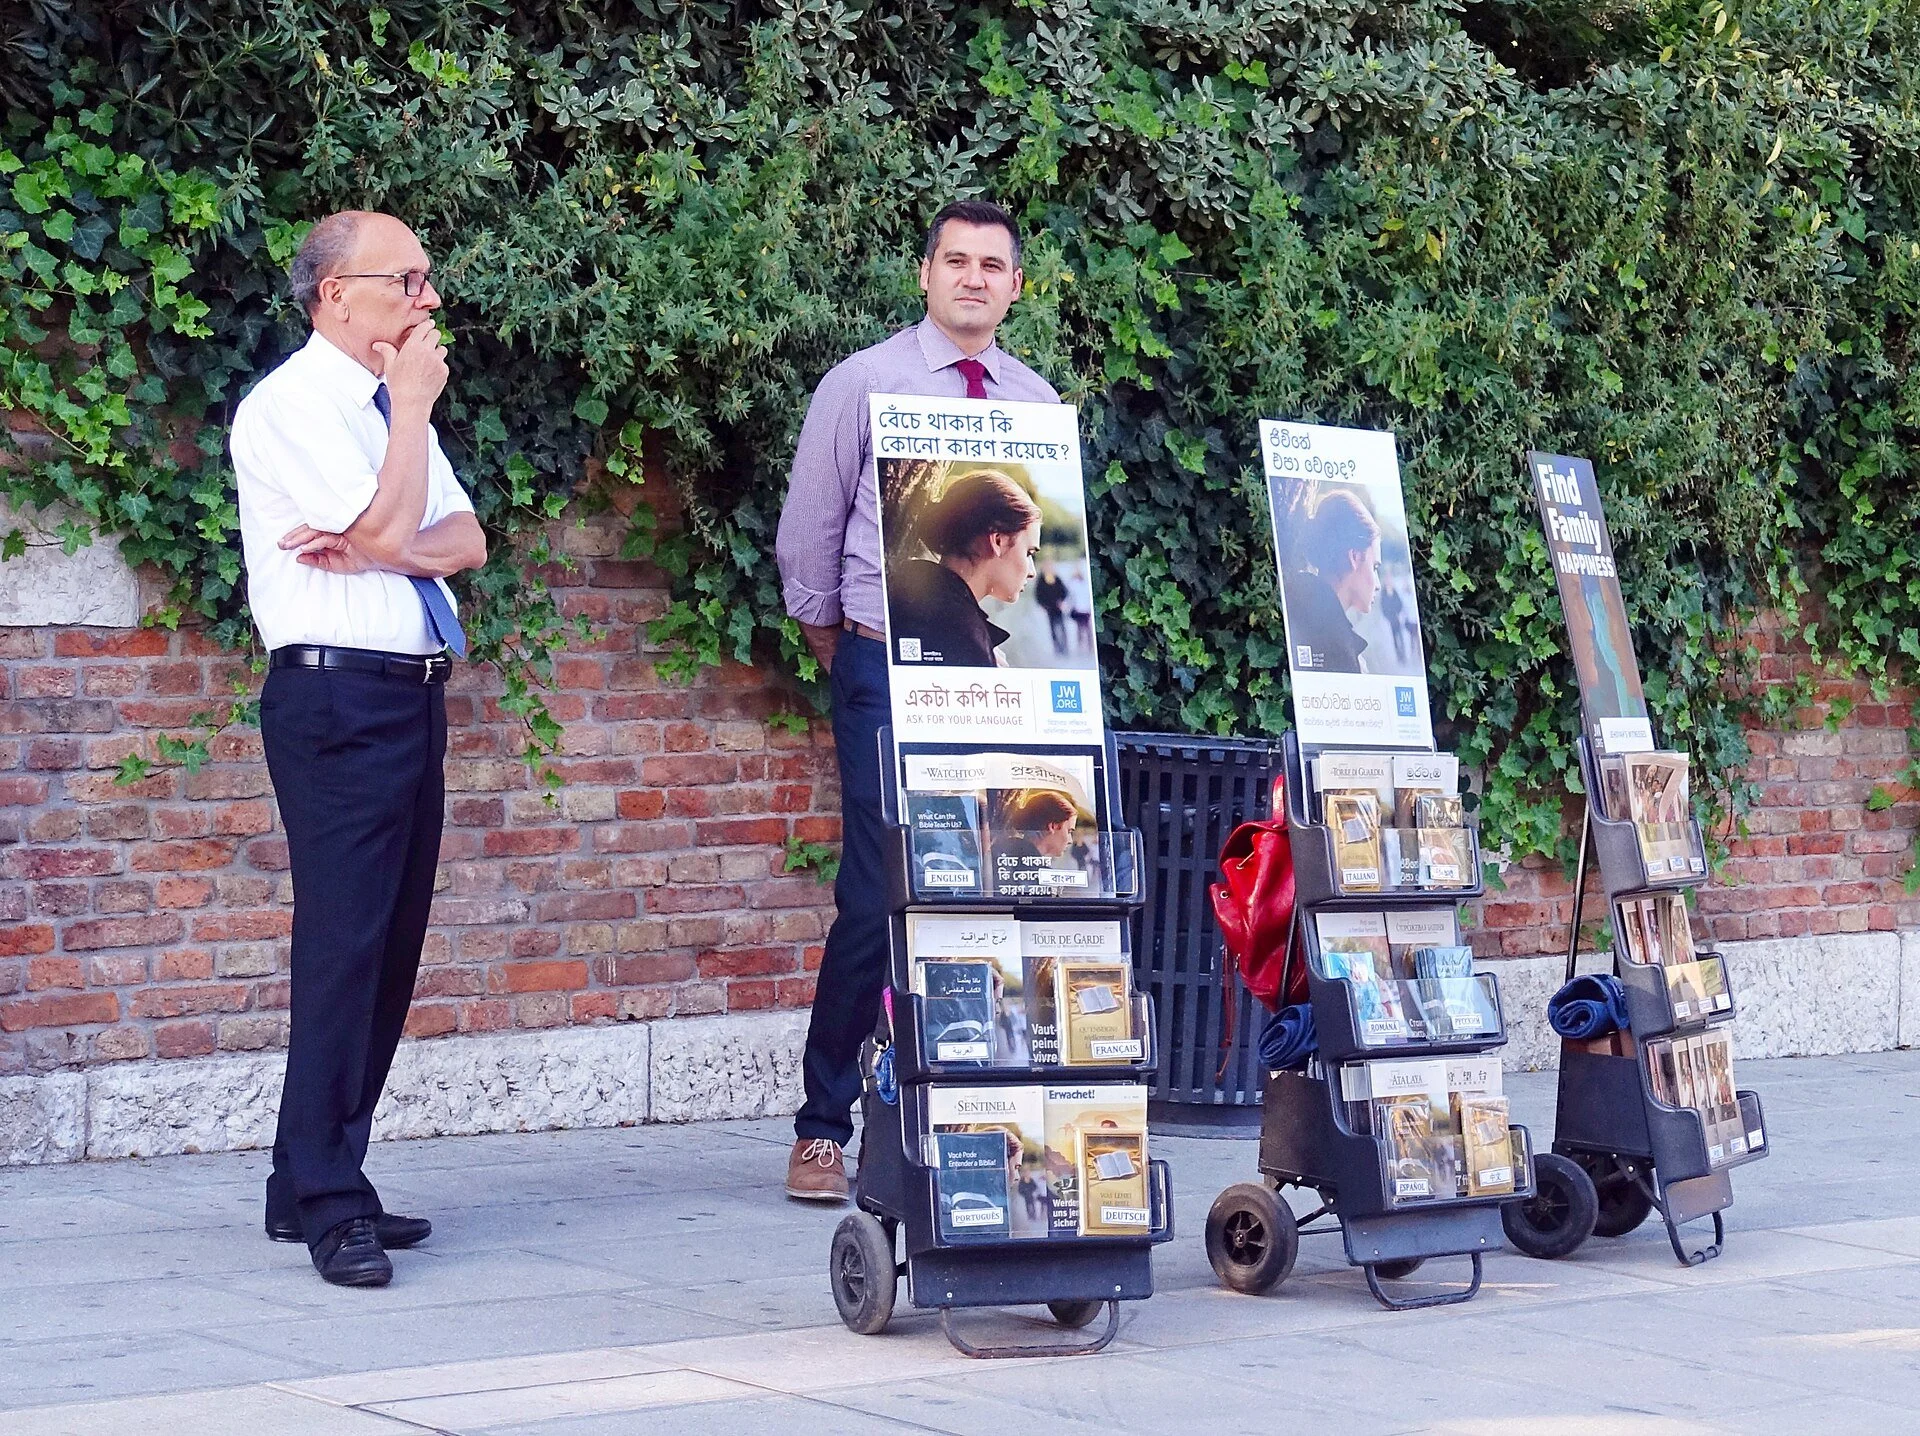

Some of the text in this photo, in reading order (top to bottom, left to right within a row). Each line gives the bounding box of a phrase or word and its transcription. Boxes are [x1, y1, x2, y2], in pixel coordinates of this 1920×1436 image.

[879, 404, 1013, 433] বেঁচে থাকার কি
[881, 435, 940, 455] কোনো
[945, 438, 996, 457] কারণ
[1537, 464, 1582, 506] Find
[1547, 507, 1602, 554] Family
[1557, 552, 1615, 577] HAPPINESS
[905, 683, 1022, 708] একটা কপি নিন
[1057, 685, 1076, 698] JW
[1400, 691, 1412, 703] JW
[906, 715, 1023, 726] ASK FOR YOUR LANGUAGE
[997, 853, 1052, 867] বেঁচে থাকার
[930, 873, 969, 884] ENGLISH
[998, 867, 1010, 881] কি
[1051, 874, 1075, 884] বাংলা
[1345, 872, 1376, 882] ITALIANO
[961, 932, 1007, 945] برج المراقبة
[1032, 933, 1105, 945] TOUR DE GARDE
[952, 1045, 974, 1055] العربية
[1095, 1044, 1138, 1055] FRANÇAIS
[1033, 1051, 1057, 1063] vivre
[1392, 1074, 1423, 1086] ATALAYA
[1048, 1089, 1095, 1100] Erwachet!
[957, 1100, 1016, 1112] SENTINELA
[947, 1150, 977, 1159] Você Pode
[1400, 1181, 1425, 1192] ESPAÑOL
[955, 1211, 1001, 1224] PORTUGUÊS
[1053, 1210, 1067, 1218] uns
[1105, 1211, 1146, 1221] DEUTSCH
[1053, 1218, 1077, 1228] sicher
